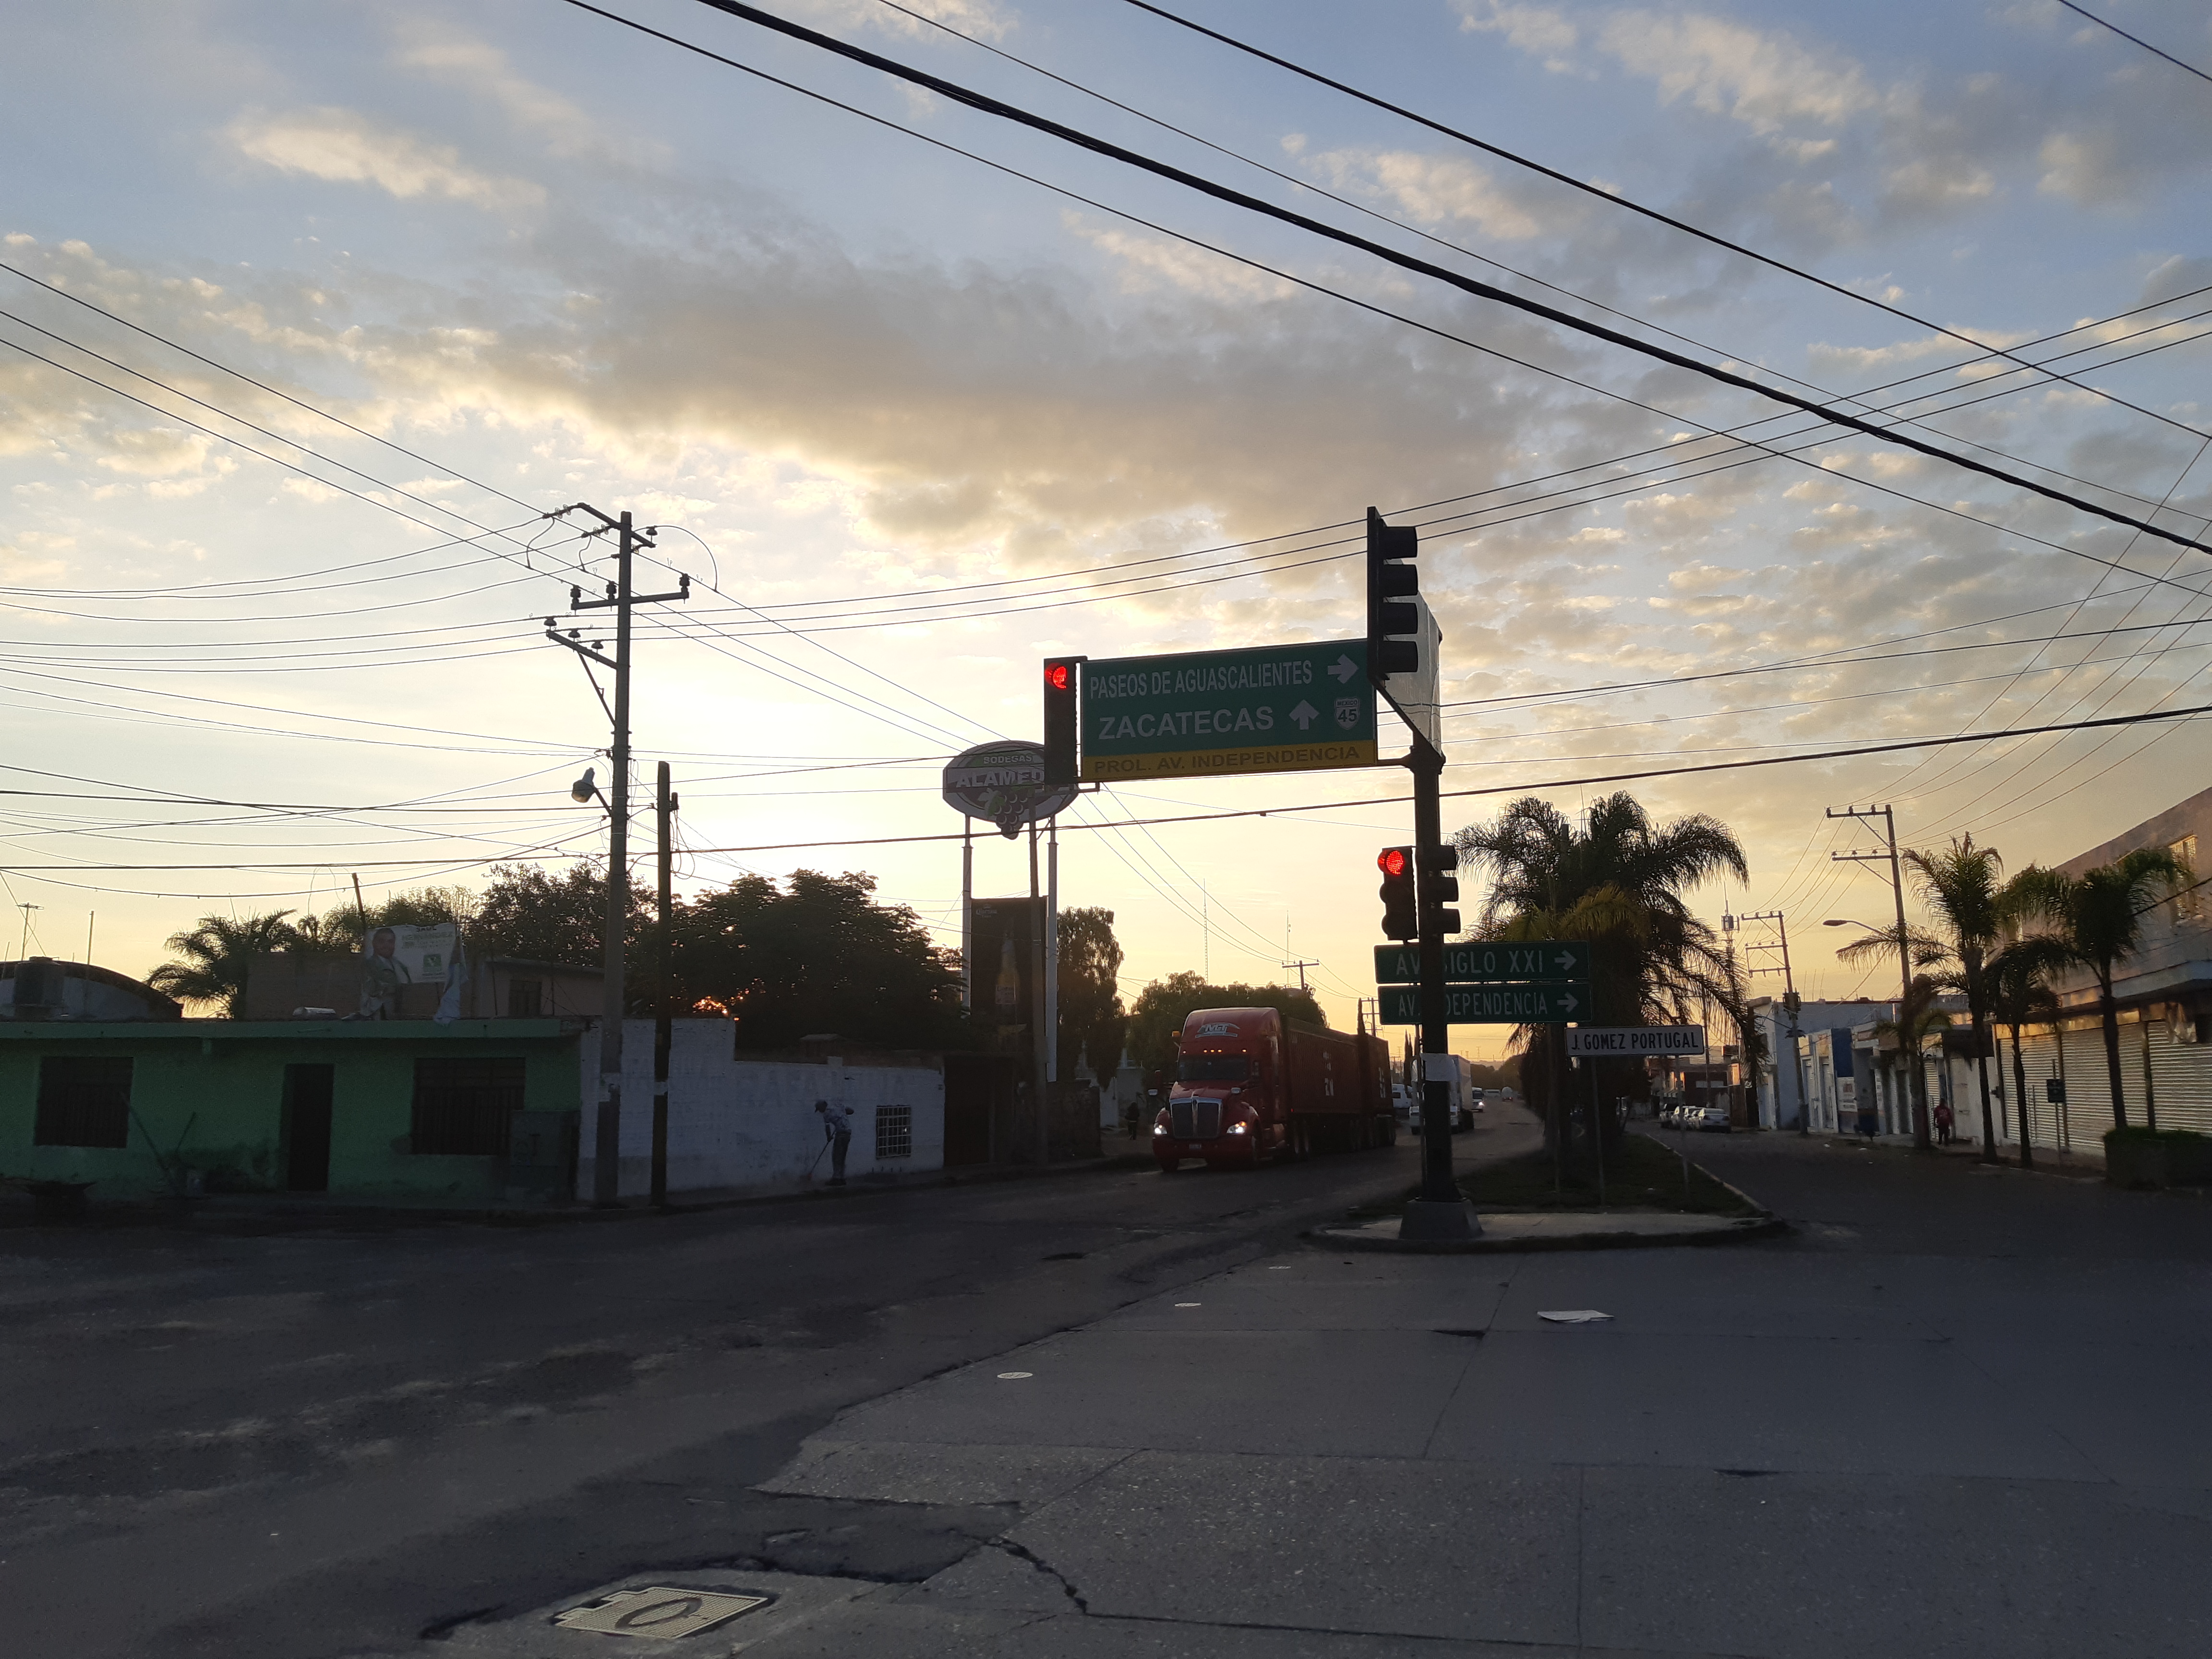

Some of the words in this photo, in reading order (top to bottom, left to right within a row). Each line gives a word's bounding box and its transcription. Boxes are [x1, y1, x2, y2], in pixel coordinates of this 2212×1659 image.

[1090, 673, 1147, 699] PASEOS
[1152, 671, 1171, 695] DE
[1175, 660, 1312, 693] AGUASCALIENTES
[1098, 706, 1274, 740] ZACATECAS
[1337, 709, 1358, 722] 45
[983, 754, 1033, 765] BODEGAS
[1094, 759, 1151, 773] PROL.
[1157, 756, 1185, 770] AV.
[1192, 746, 1360, 768] INDEPENDENCIA
[956, 769, 1045, 788] ALAMED
[1444, 950, 1496, 974] IGLO
[1508, 950, 1543, 973] XXI
[1571, 1034, 1580, 1050] J.
[1584, 1033, 1626, 1050] GOMEZ
[1631, 1032, 1699, 1049] PORTUGAL
